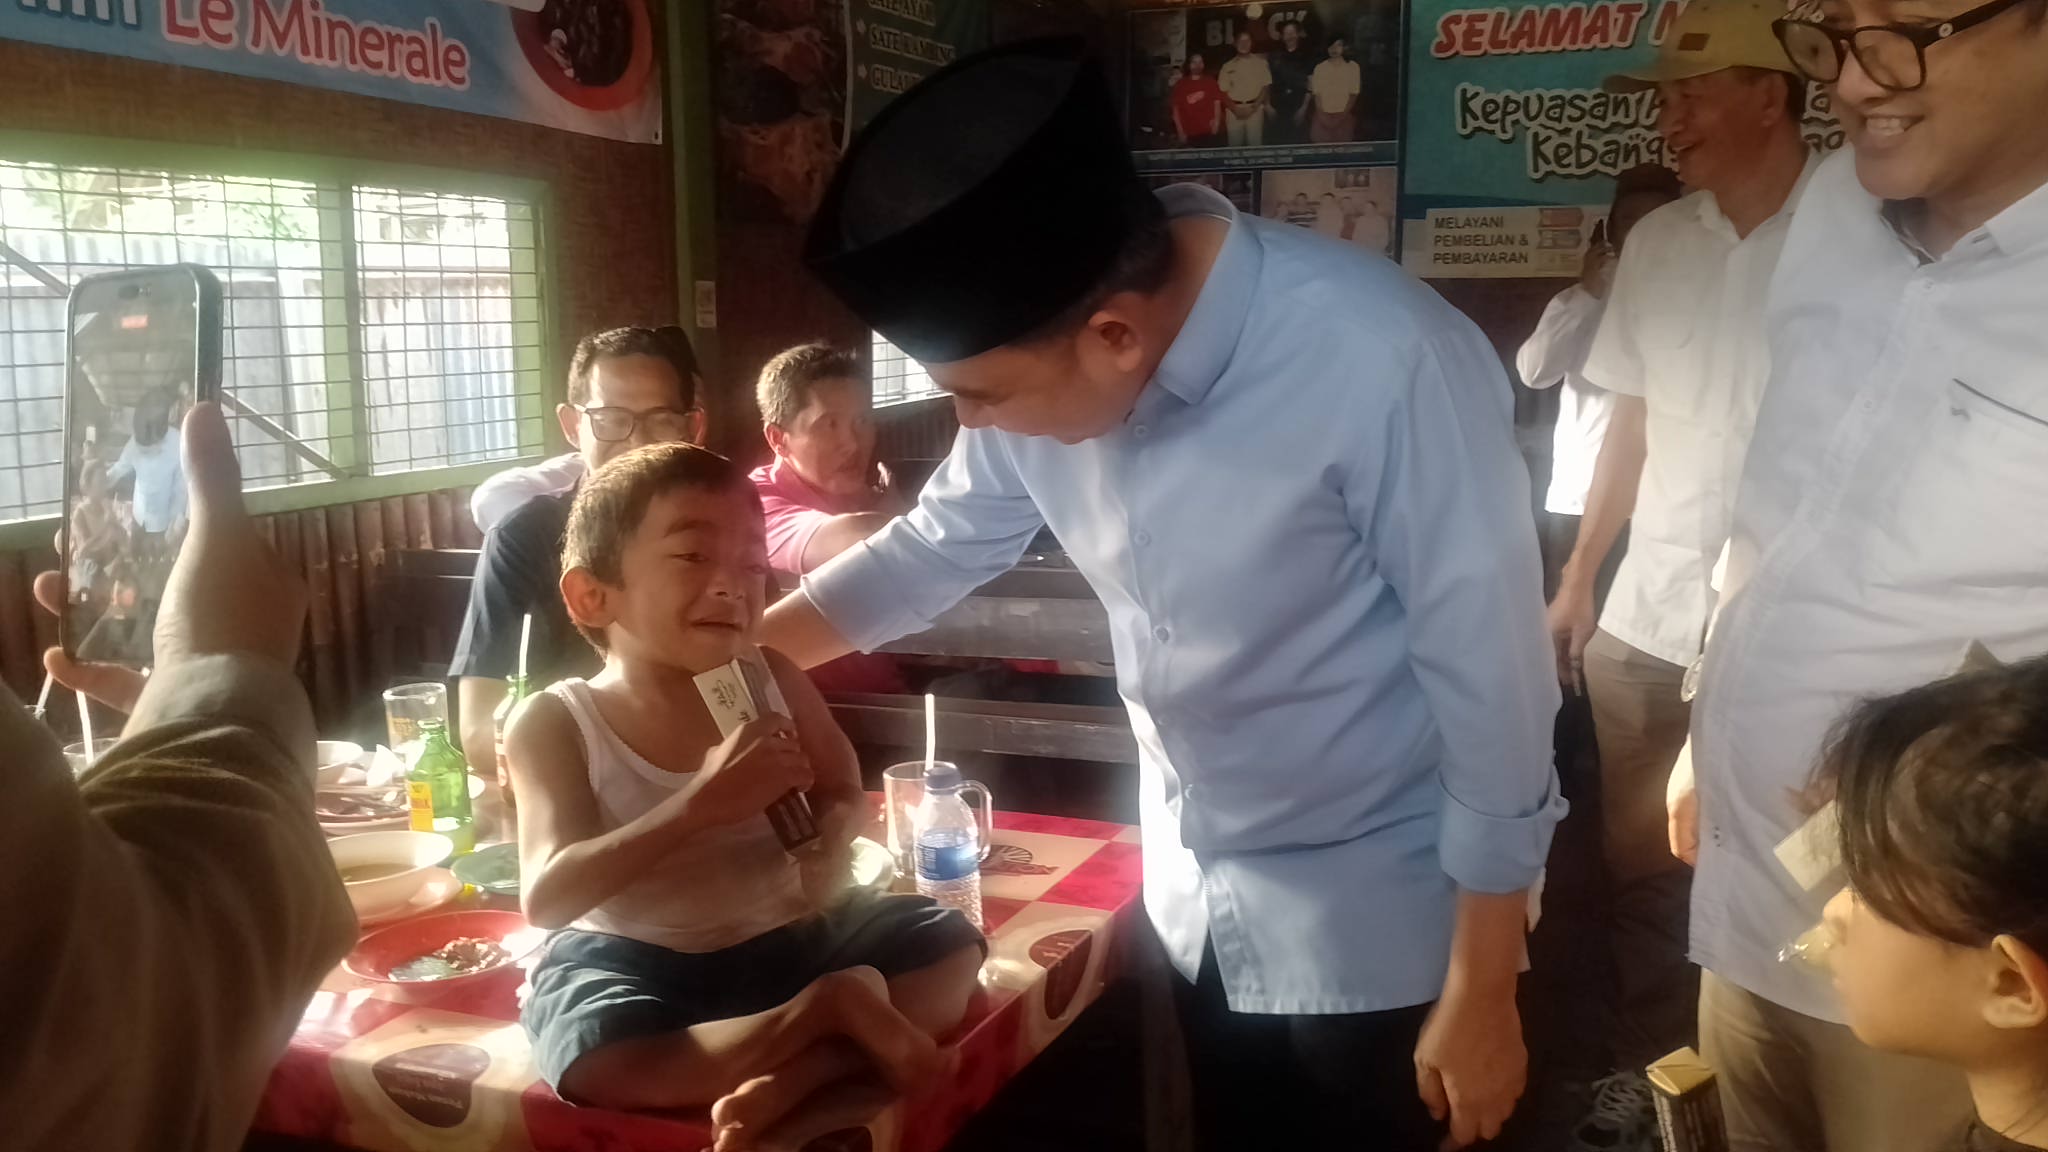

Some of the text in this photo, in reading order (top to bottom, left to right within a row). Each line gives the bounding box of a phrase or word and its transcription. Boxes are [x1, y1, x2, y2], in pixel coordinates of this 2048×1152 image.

[251, 0, 467, 85] Minerale
[1432, 2, 1645, 55] SELAMAT
[1460, 88, 1633, 130] Kepuasan
[1434, 215, 1504, 229] MELAYANI
[1434, 233, 1529, 247] PEMBELIAN &
[1433, 252, 1528, 265] PEMBAYARAN
